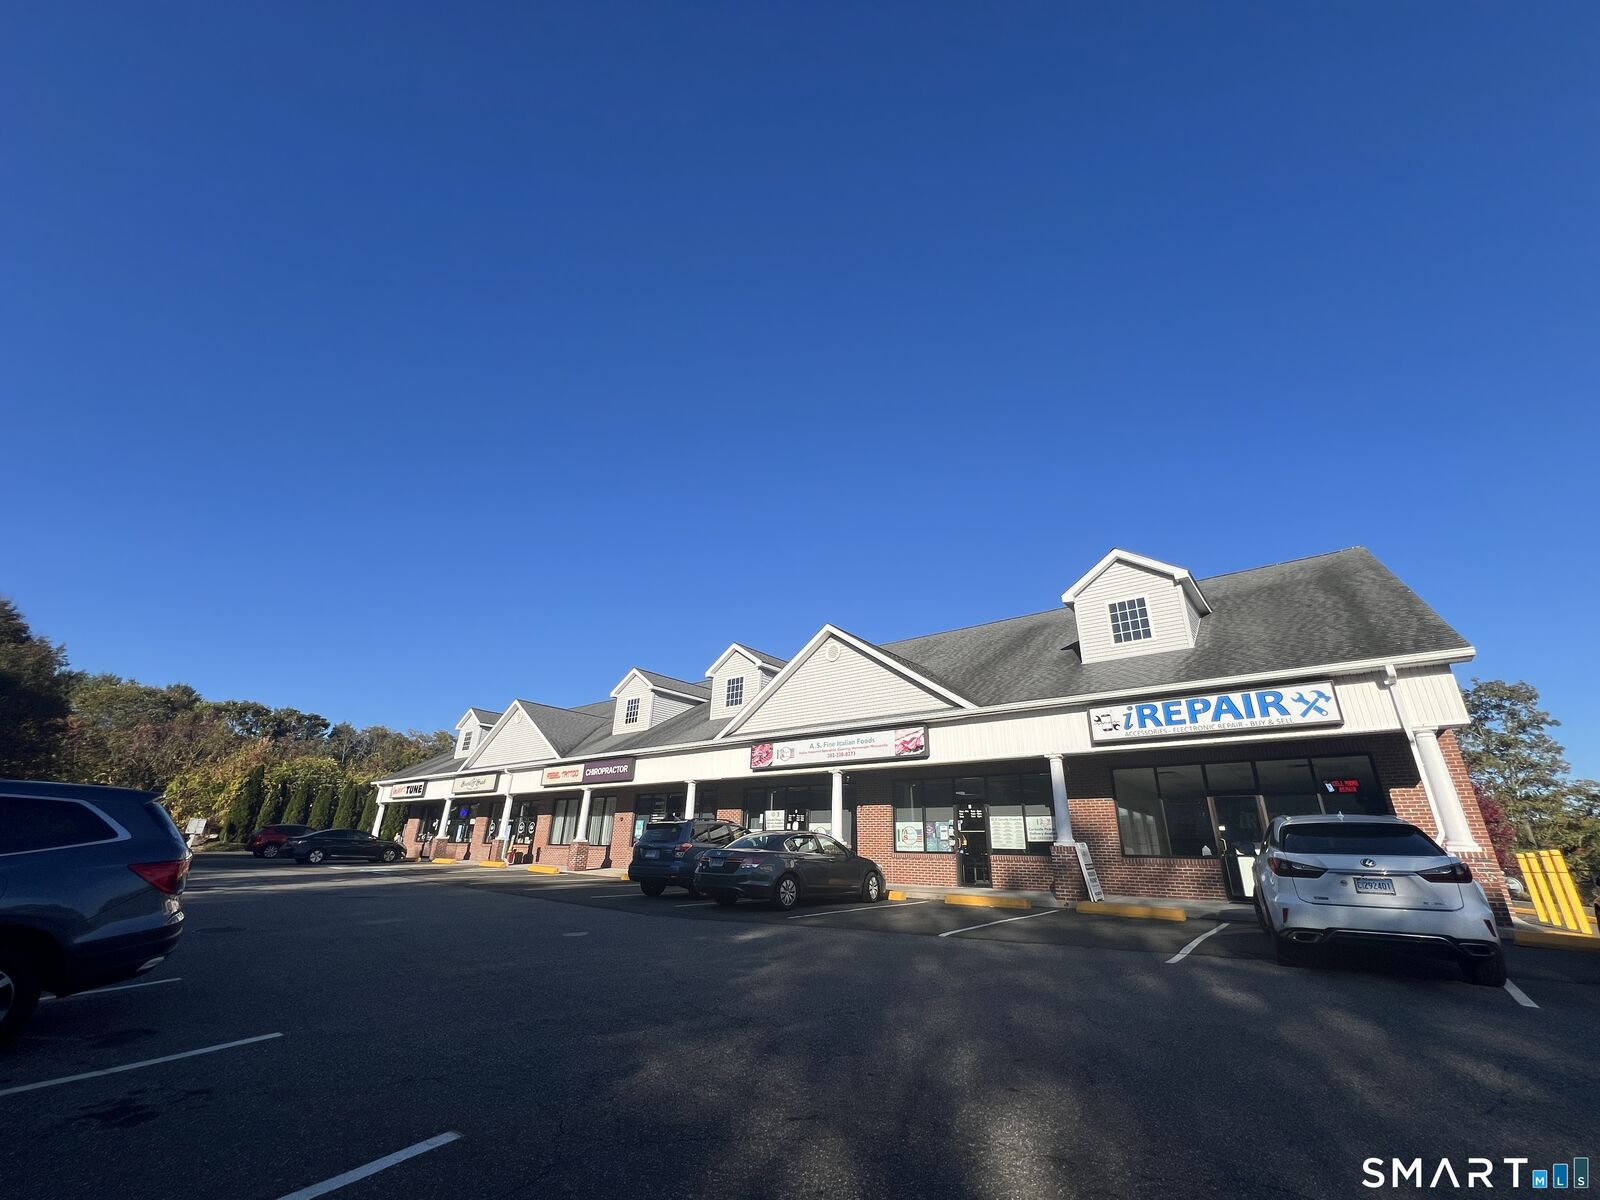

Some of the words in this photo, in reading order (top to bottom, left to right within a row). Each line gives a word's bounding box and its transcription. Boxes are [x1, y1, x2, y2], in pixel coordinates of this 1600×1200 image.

[1122, 690, 1291, 731] iREPAIR
[1124, 727, 1167, 737] ACCESSORIES
[1172, 723, 1215, 734] ELECTRONIC
[1217, 721, 1243, 729] REPAIR
[1250, 719, 1265, 727] BUY
[1275, 717, 1293, 725] SELL
[836, 739, 855, 747] Italian
[856, 737, 875, 745] Foods
[585, 765, 629, 777] CHIROPRACTOR
[406, 784, 423, 795] TUNE
